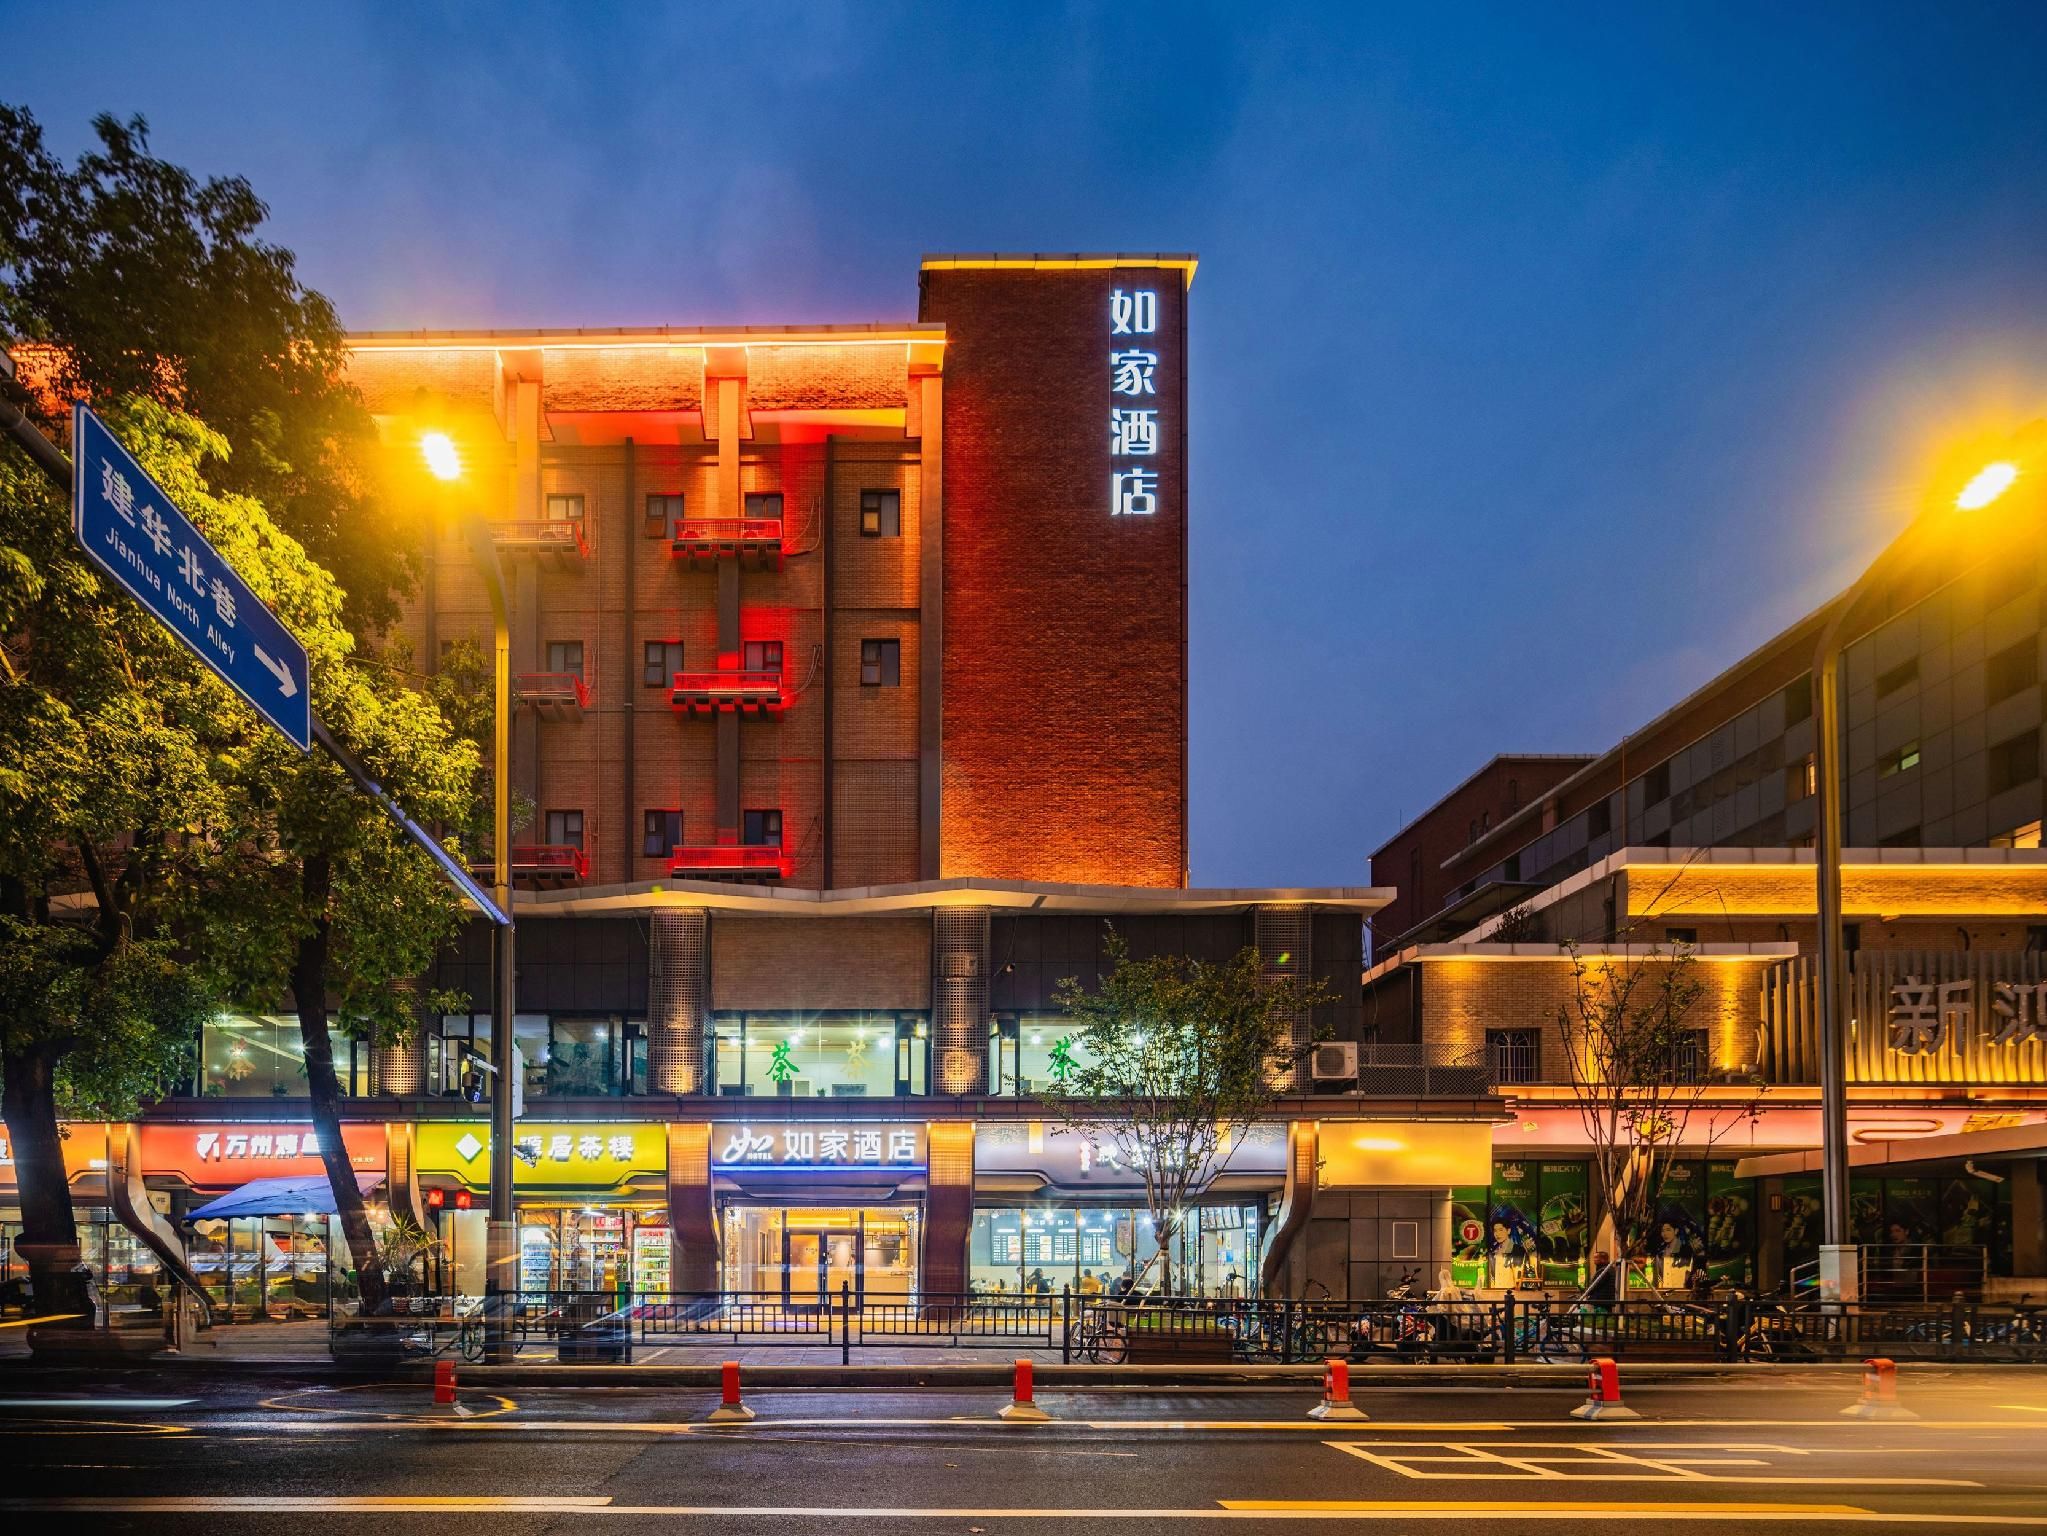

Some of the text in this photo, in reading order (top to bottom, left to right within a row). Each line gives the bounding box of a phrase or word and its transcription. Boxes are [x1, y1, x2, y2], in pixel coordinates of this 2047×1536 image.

[1110, 288, 1158, 516] 如家酒店
[101, 457, 236, 628] 建华北巷
[105, 527, 236, 665] Jianhua North Alley
[765, 1040, 800, 1084] 茶
[1047, 1036, 1081, 1081] 茶
[747, 1152, 773, 1160] HOTEL
[783, 1129, 917, 1160] 如家酒店
